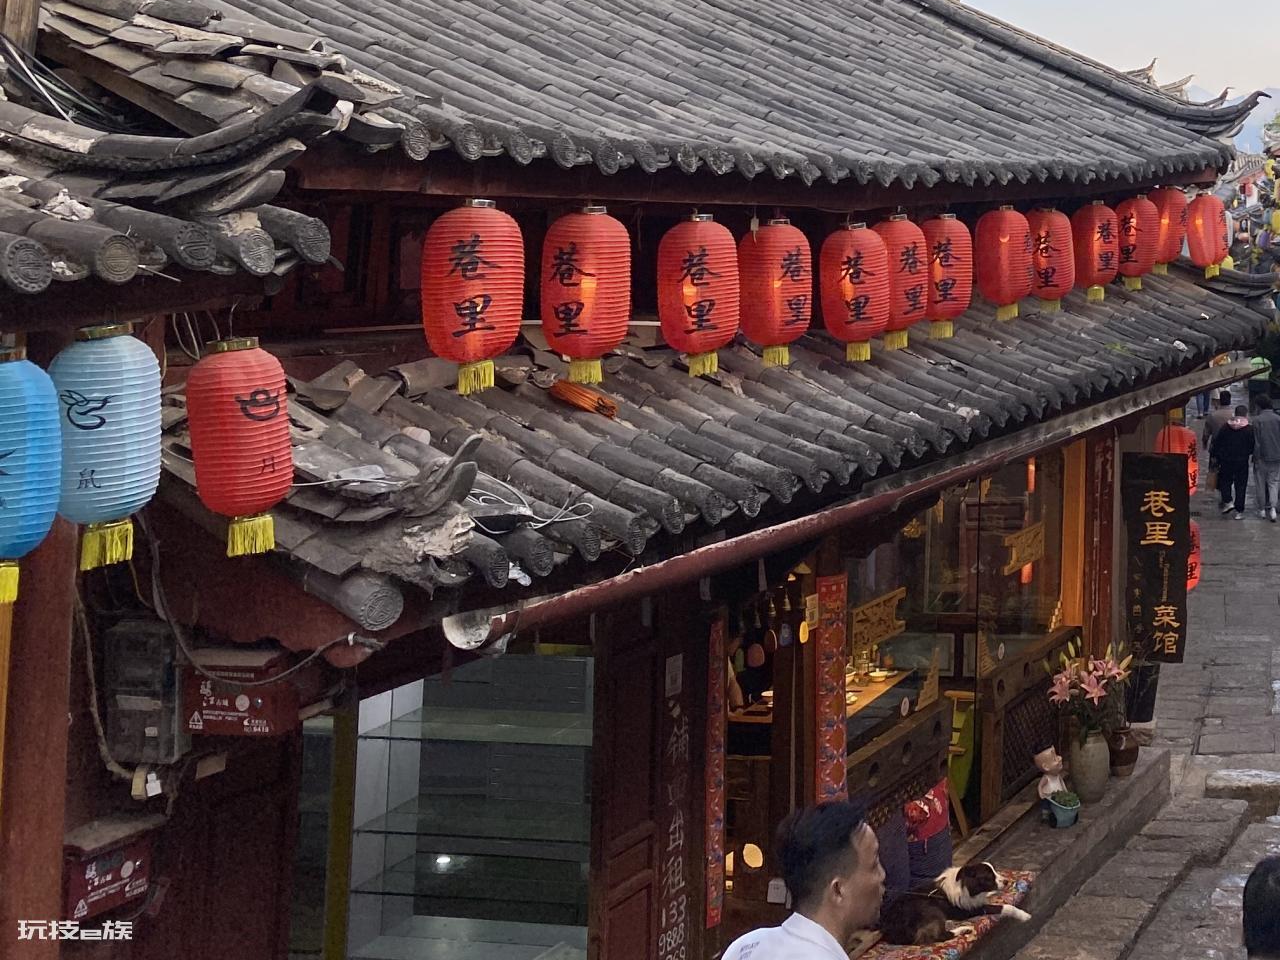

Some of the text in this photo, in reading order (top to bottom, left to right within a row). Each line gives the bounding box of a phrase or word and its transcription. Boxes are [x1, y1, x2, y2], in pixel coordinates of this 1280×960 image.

[933, 238, 963, 304] 巷里
[1032, 230, 1061, 289] 巷里
[1094, 220, 1117, 272] 巷里
[1118, 211, 1143, 264] 巷里
[448, 234, 501, 339] 巷里
[548, 241, 597, 338] 巷里
[678, 247, 720, 336] 巷里
[779, 247, 809, 327] 巷里
[839, 251, 875, 325] 巷里
[899, 241, 925, 315] 巷里
[76, 467, 101, 490] 鼠
[1140, 490, 1181, 655] 巷里 菜馆
[658, 922, 685, 956] 9888
[661, 894, 687, 928] 133
